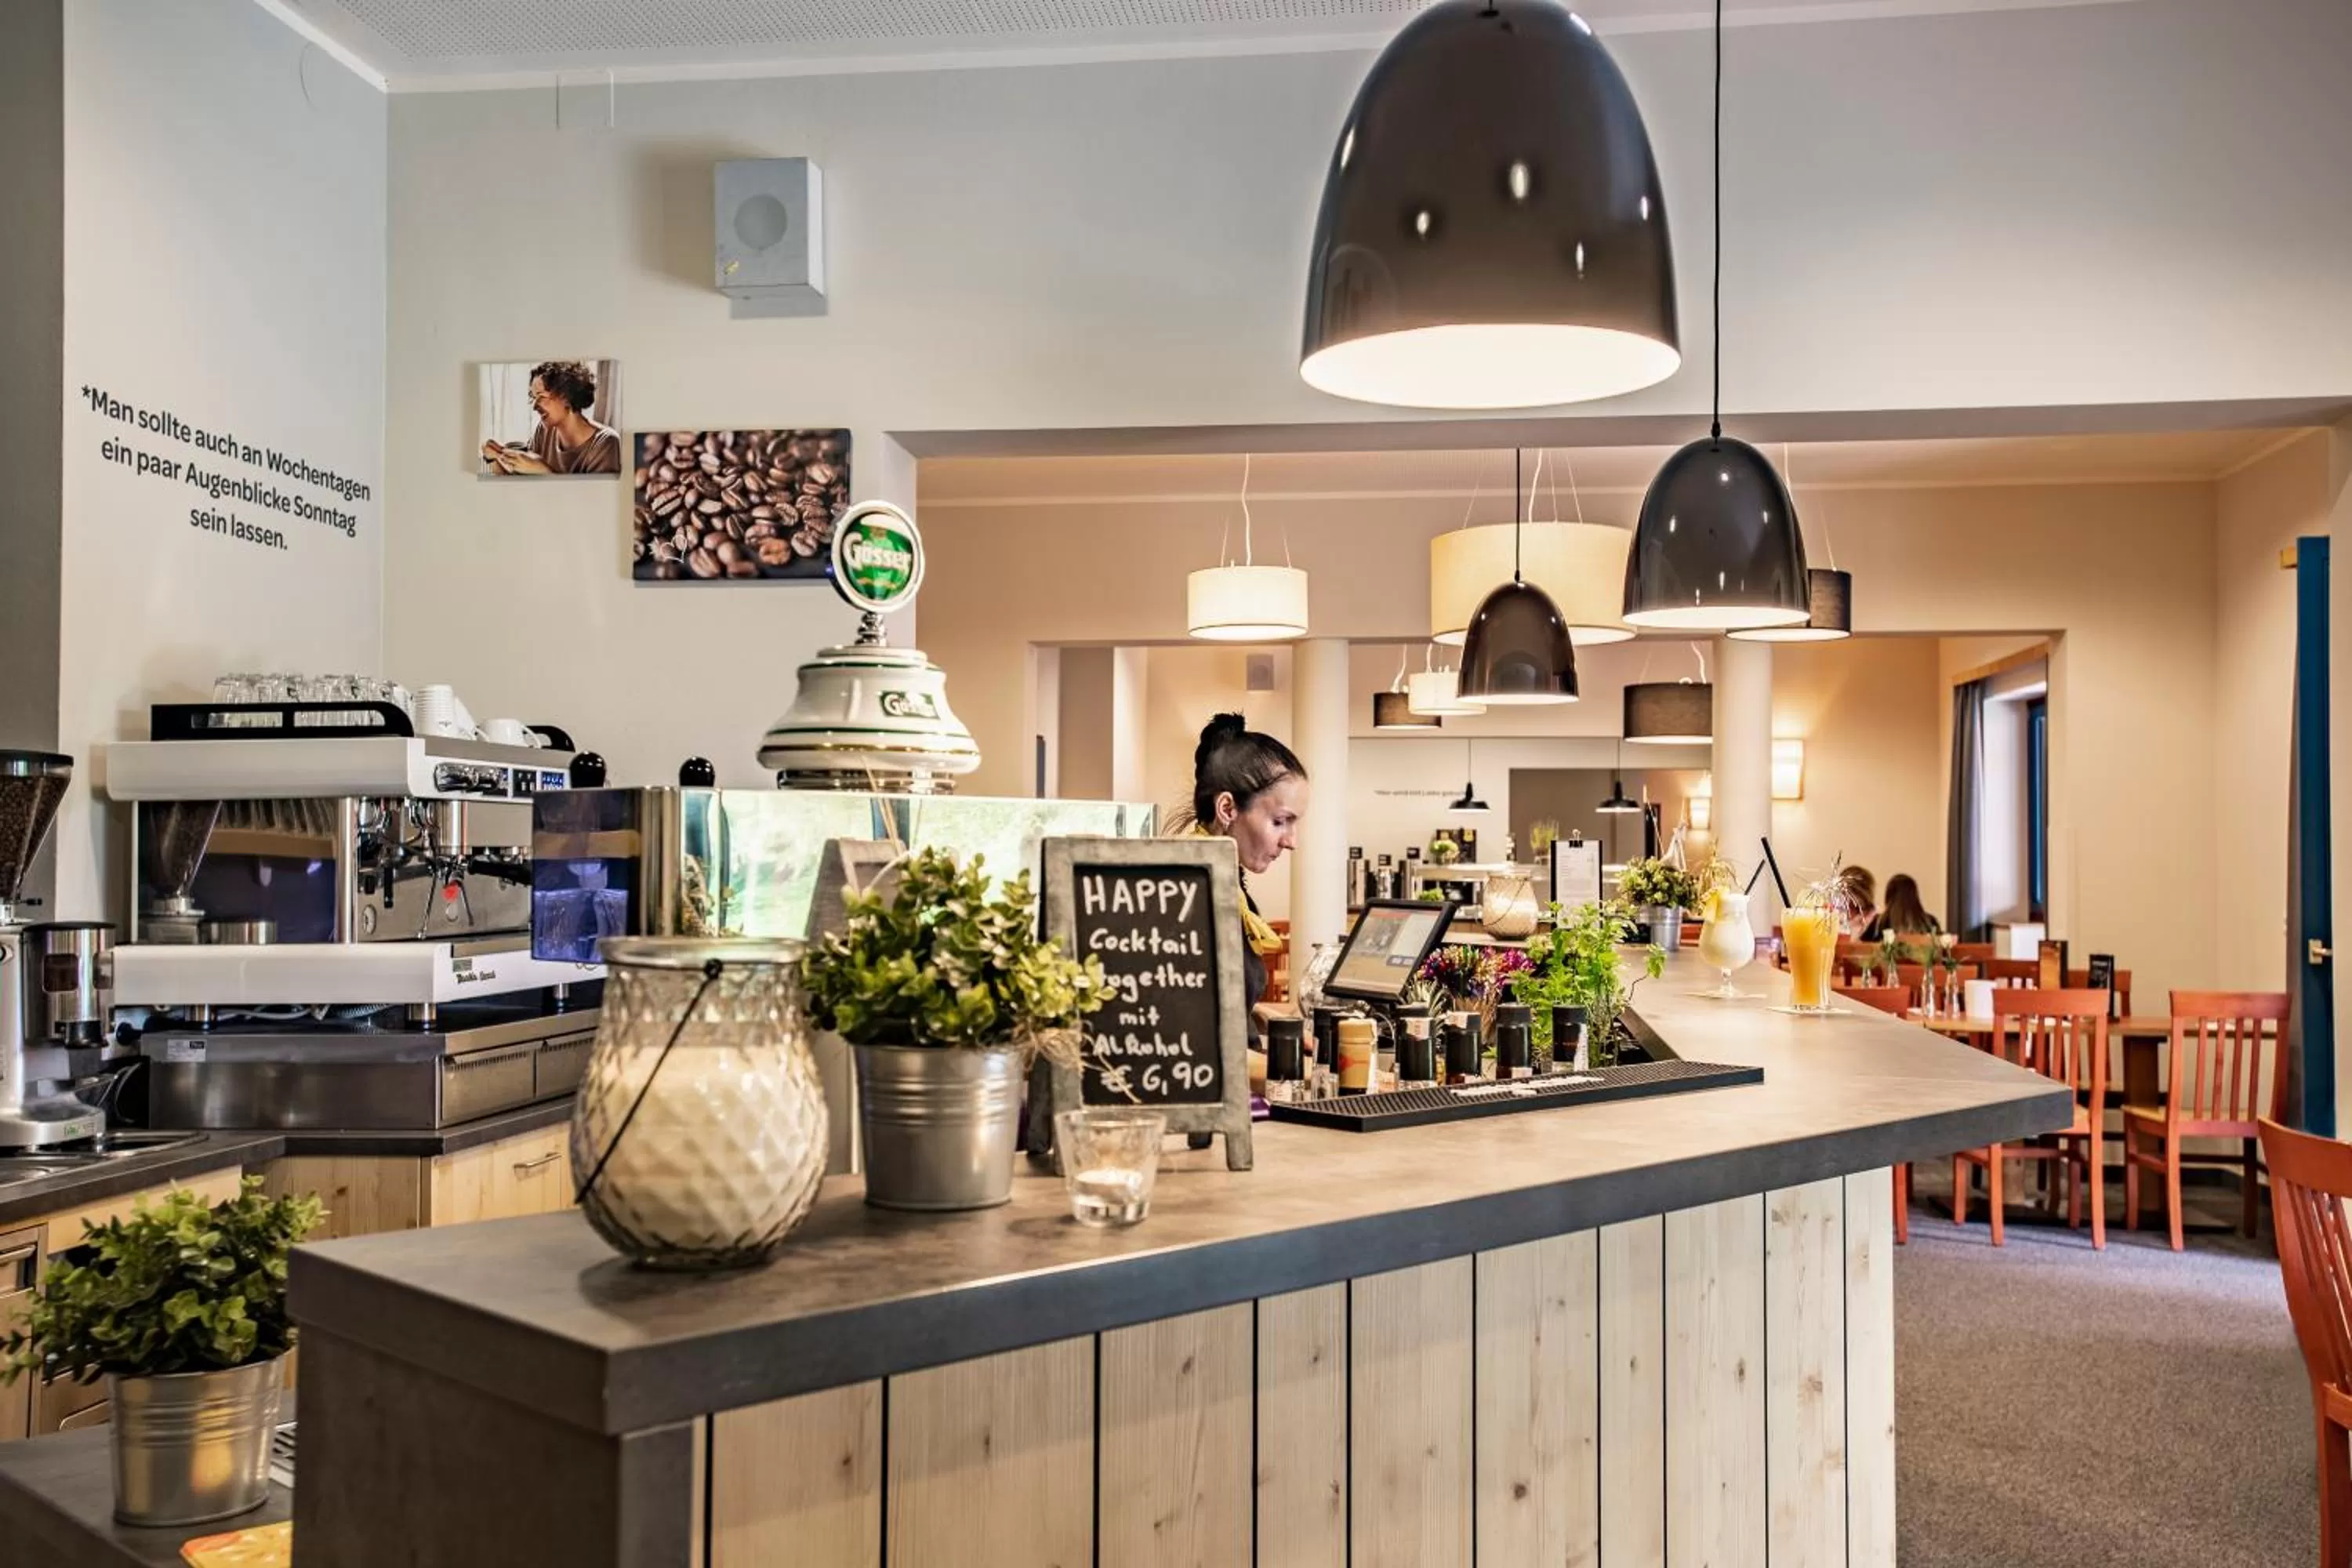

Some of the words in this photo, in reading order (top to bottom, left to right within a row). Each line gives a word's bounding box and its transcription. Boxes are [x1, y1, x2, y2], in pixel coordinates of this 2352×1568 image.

[137, 410, 191, 443] sollte
[194, 429, 238, 459] auch
[241, 445, 263, 467] an
[266, 448, 371, 502] Wochentagen
[101, 436, 132, 466] ein
[136, 450, 183, 481] paar
[185, 462, 291, 514] Augenblicke
[293, 495, 357, 538] Sonntag
[190, 507, 227, 535] sein
[230, 514, 288, 550] lassen.
[1083, 874, 1197, 923] HAPPY
[1089, 926, 1203, 956] Cocktail
[1119, 1004, 1160, 1026] mit
[1142, 1061, 1214, 1096] 6,90
